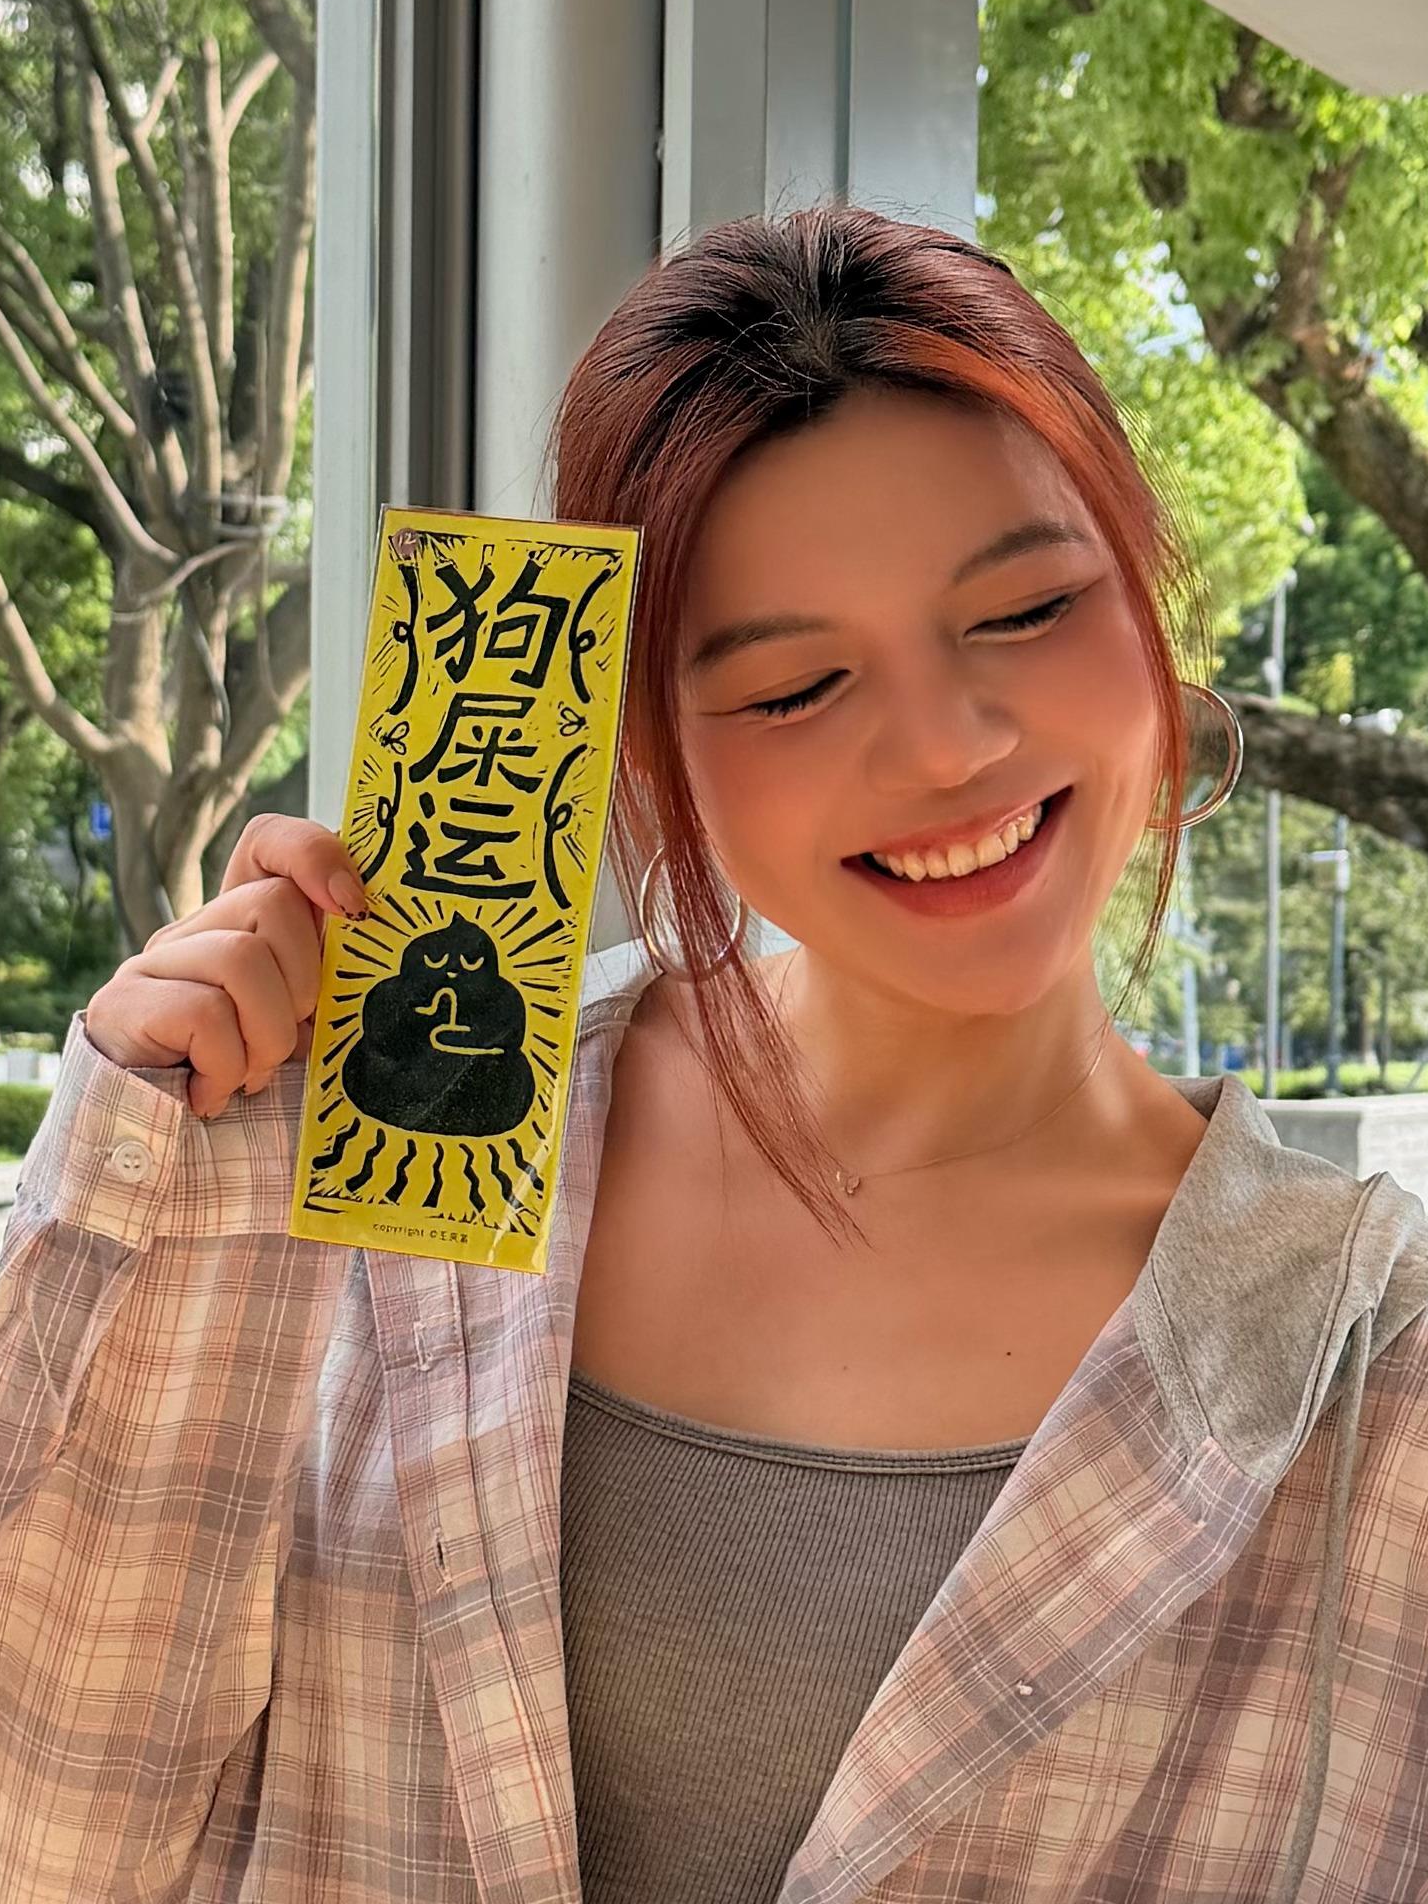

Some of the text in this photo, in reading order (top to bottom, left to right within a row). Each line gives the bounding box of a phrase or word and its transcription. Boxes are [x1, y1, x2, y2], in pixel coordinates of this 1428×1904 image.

[400, 558, 570, 902] 狗屎运
[372, 1223, 424, 1237] copyright
